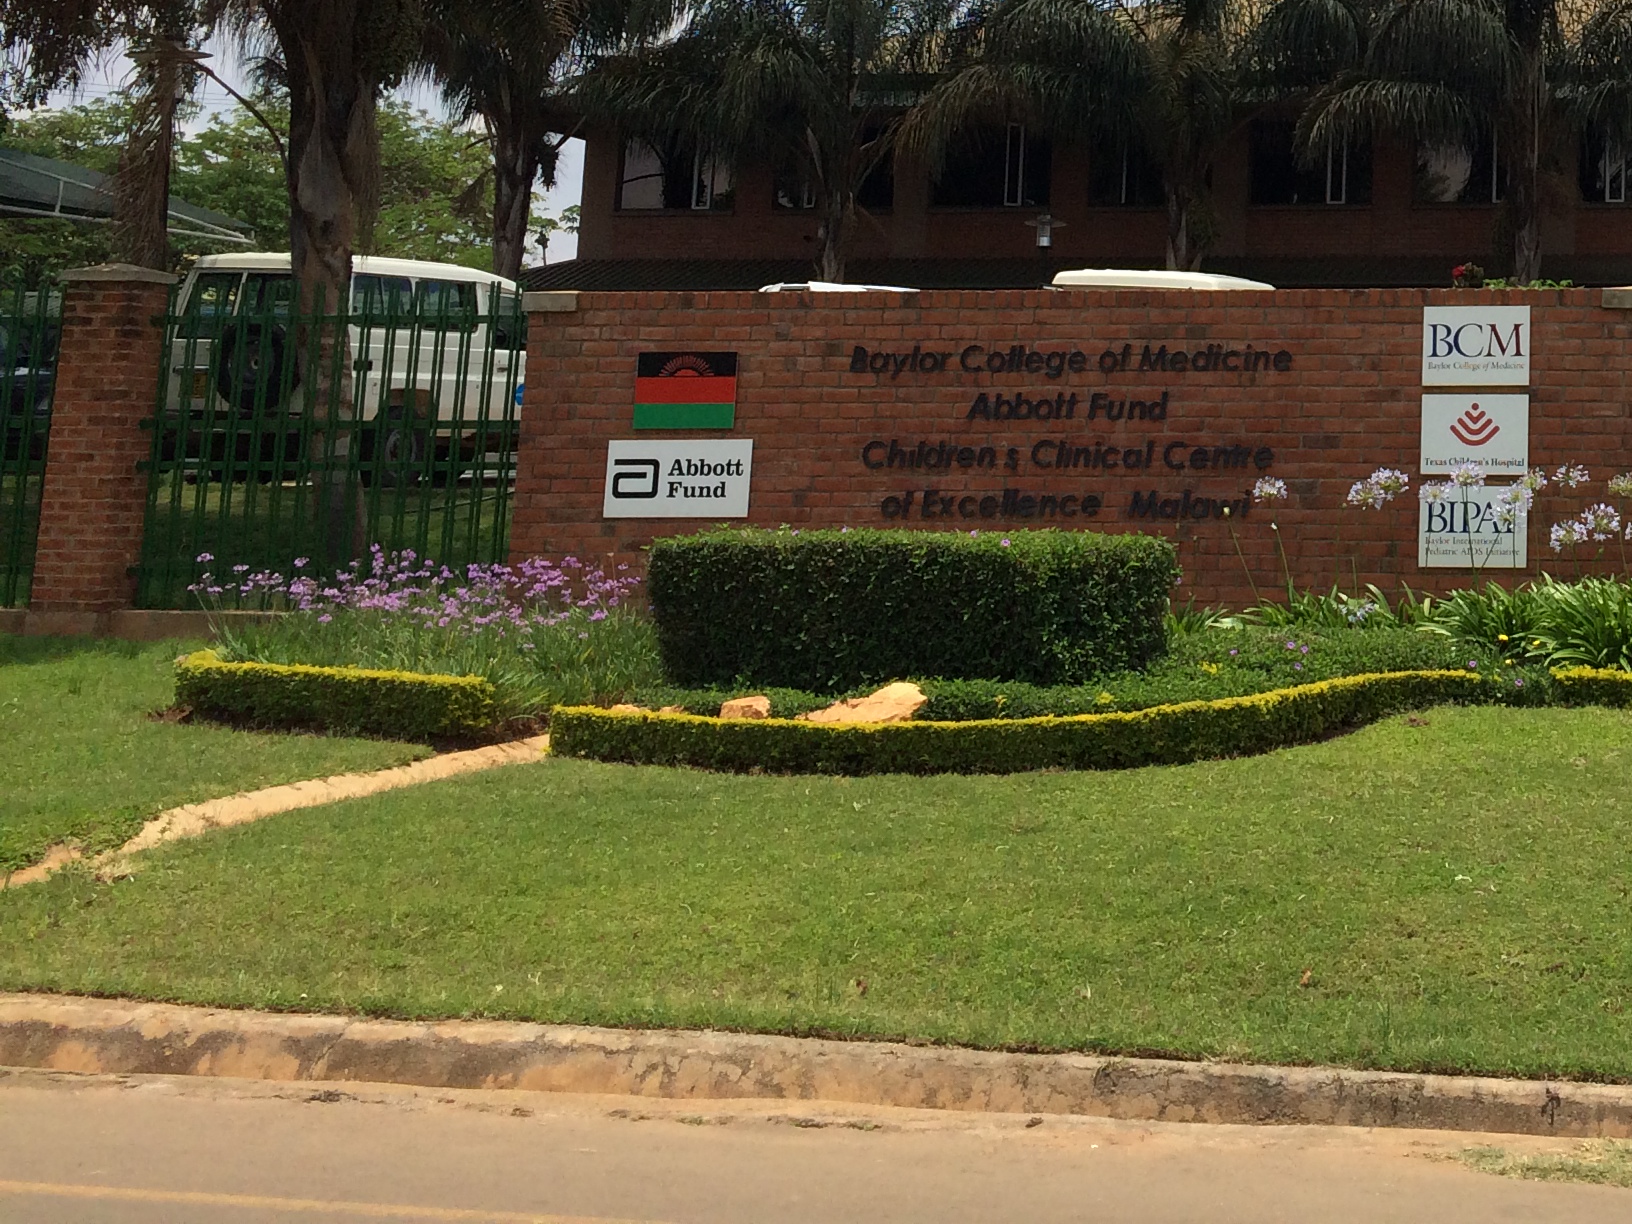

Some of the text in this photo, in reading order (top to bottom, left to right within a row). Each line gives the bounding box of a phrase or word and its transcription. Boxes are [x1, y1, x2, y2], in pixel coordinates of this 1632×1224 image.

[1427, 323, 1526, 358] BCM
[849, 344, 1292, 379] Baylor College of Medicine
[1427, 362, 1451, 371] Baylor
[1453, 362, 1480, 372] College
[1490, 362, 1525, 370] Medicine
[966, 391, 1168, 421] Abbott Fund
[667, 458, 744, 477] Abbott
[1031, 440, 1154, 469] Clinical
[1163, 440, 1275, 470] Centre
[1424, 457, 1447, 466] Texas
[1490, 457, 1525, 468] Hospital
[666, 481, 726, 498] Fund
[881, 489, 1252, 519] of Excellence Malawi
